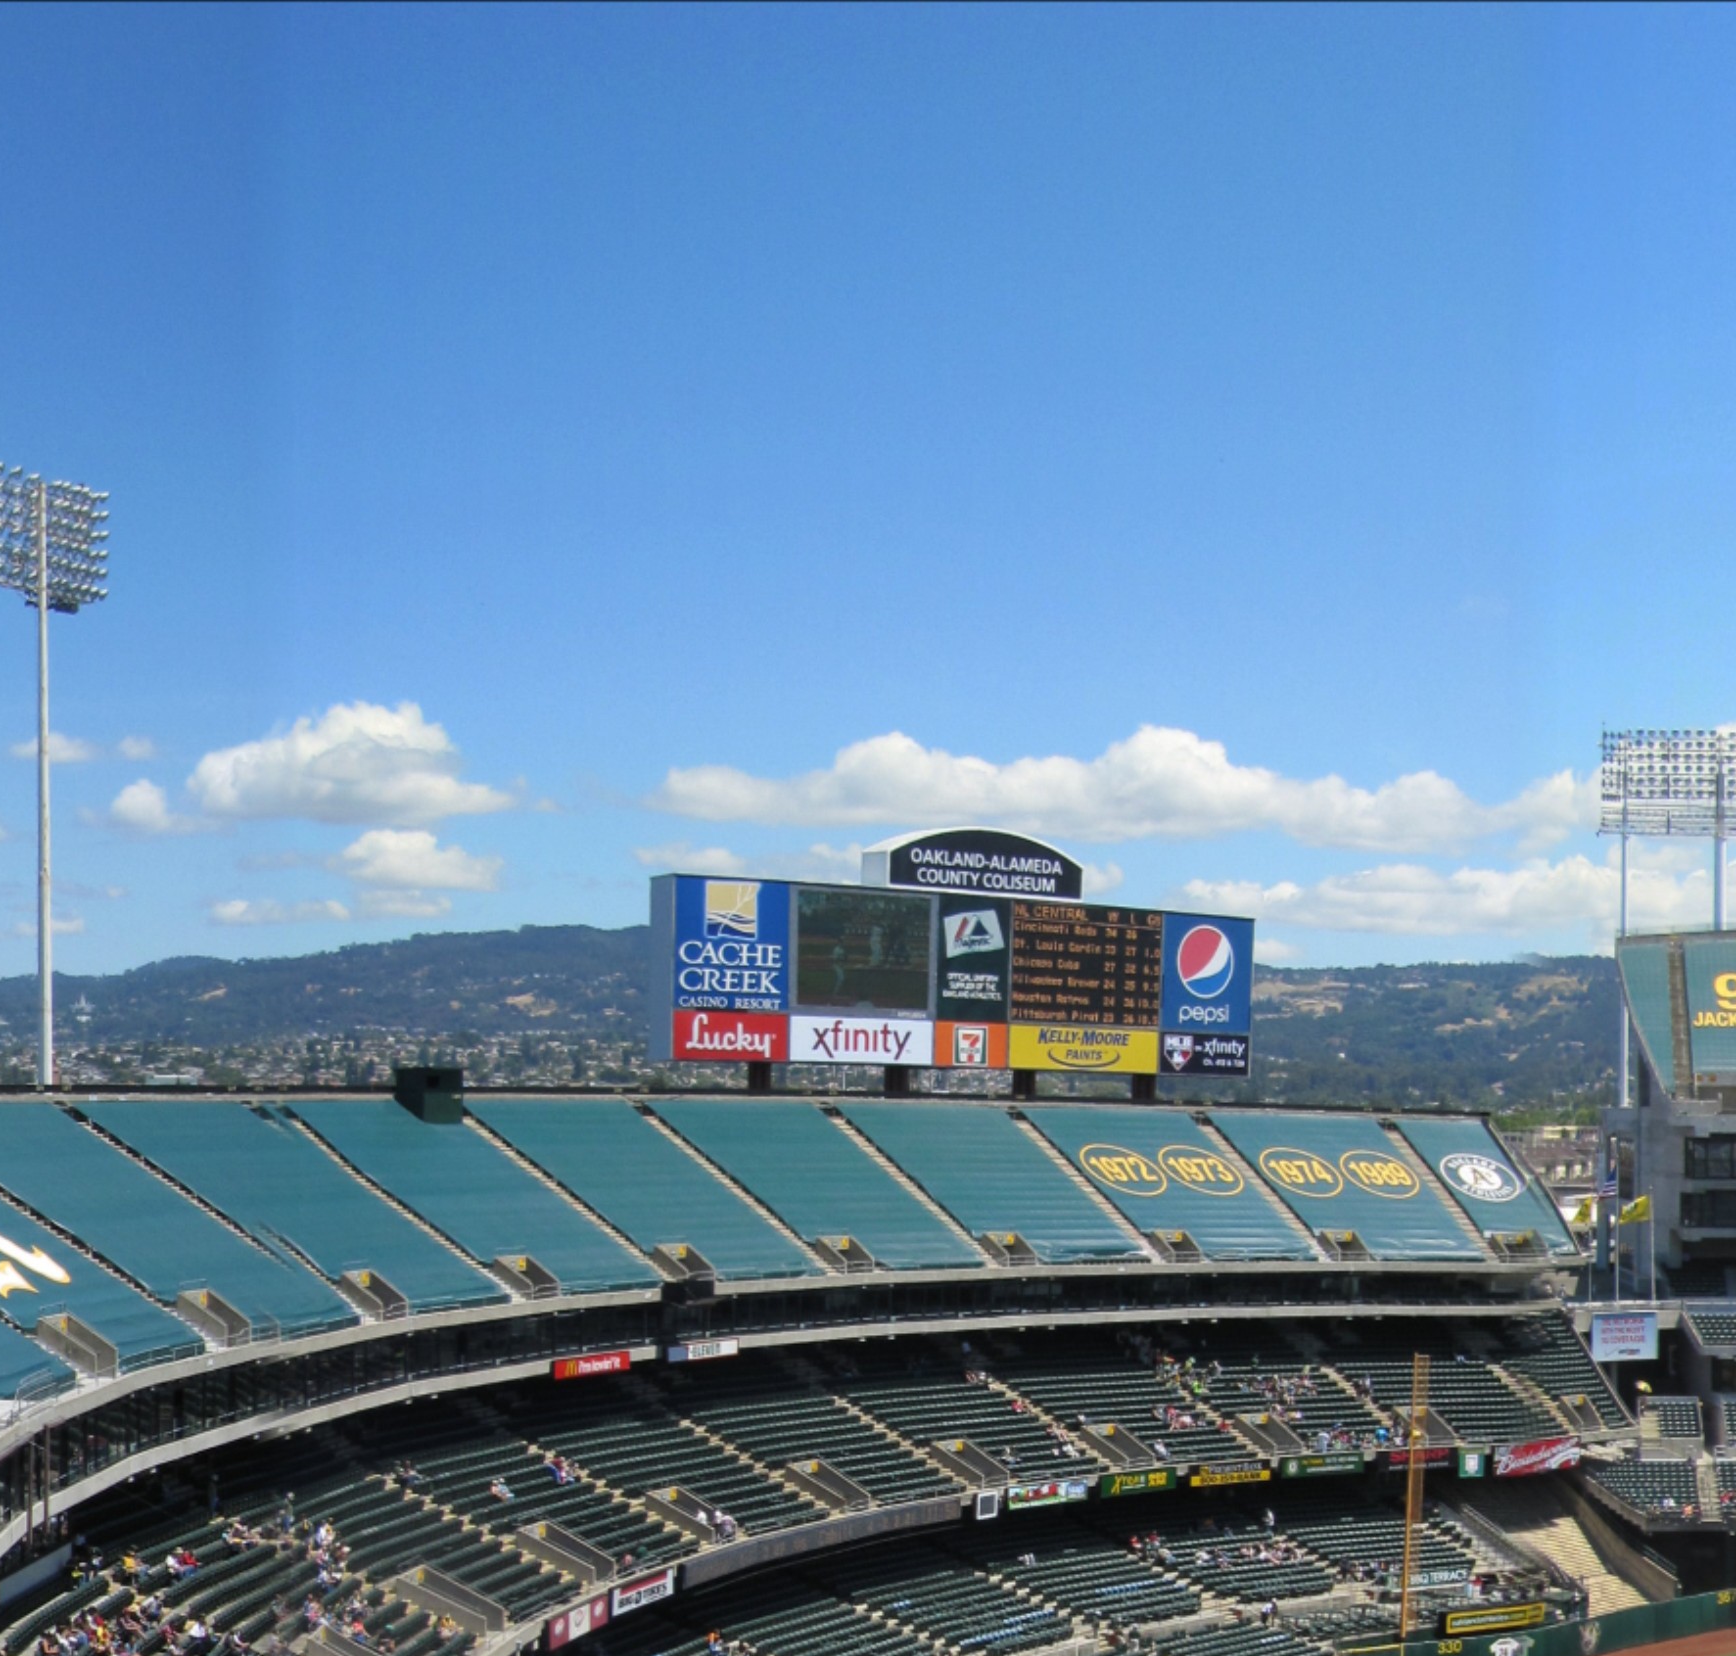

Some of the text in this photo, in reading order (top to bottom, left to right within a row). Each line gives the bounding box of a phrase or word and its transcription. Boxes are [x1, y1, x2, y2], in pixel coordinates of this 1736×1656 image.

[910, 847, 1063, 876] OAKLAND-ALAMEDA
[917, 867, 1055, 894] COUNTY COLISEUM
[1033, 905, 1089, 922] CENTRAL
[678, 940, 782, 968] CACHE
[678, 967, 781, 994] CREEK
[678, 996, 781, 1010] CASINO RESORT
[1179, 1005, 1230, 1024] pepsi
[686, 1014, 771, 1058] Lucky
[812, 1020, 912, 1061] xfinity
[1038, 1028, 1131, 1047] KELLY-MOORE
[1203, 1038, 1246, 1058] xfinity
[1065, 1049, 1103, 1060] PAINTS
[1089, 1156, 1158, 1184] 1972
[1166, 1155, 1235, 1184] 1973
[1266, 1159, 1335, 1185] 1974
[1348, 1160, 1411, 1187] 1989
[1498, 1437, 1579, 1474] Budweiser
[1437, 1640, 1463, 1655] 330
